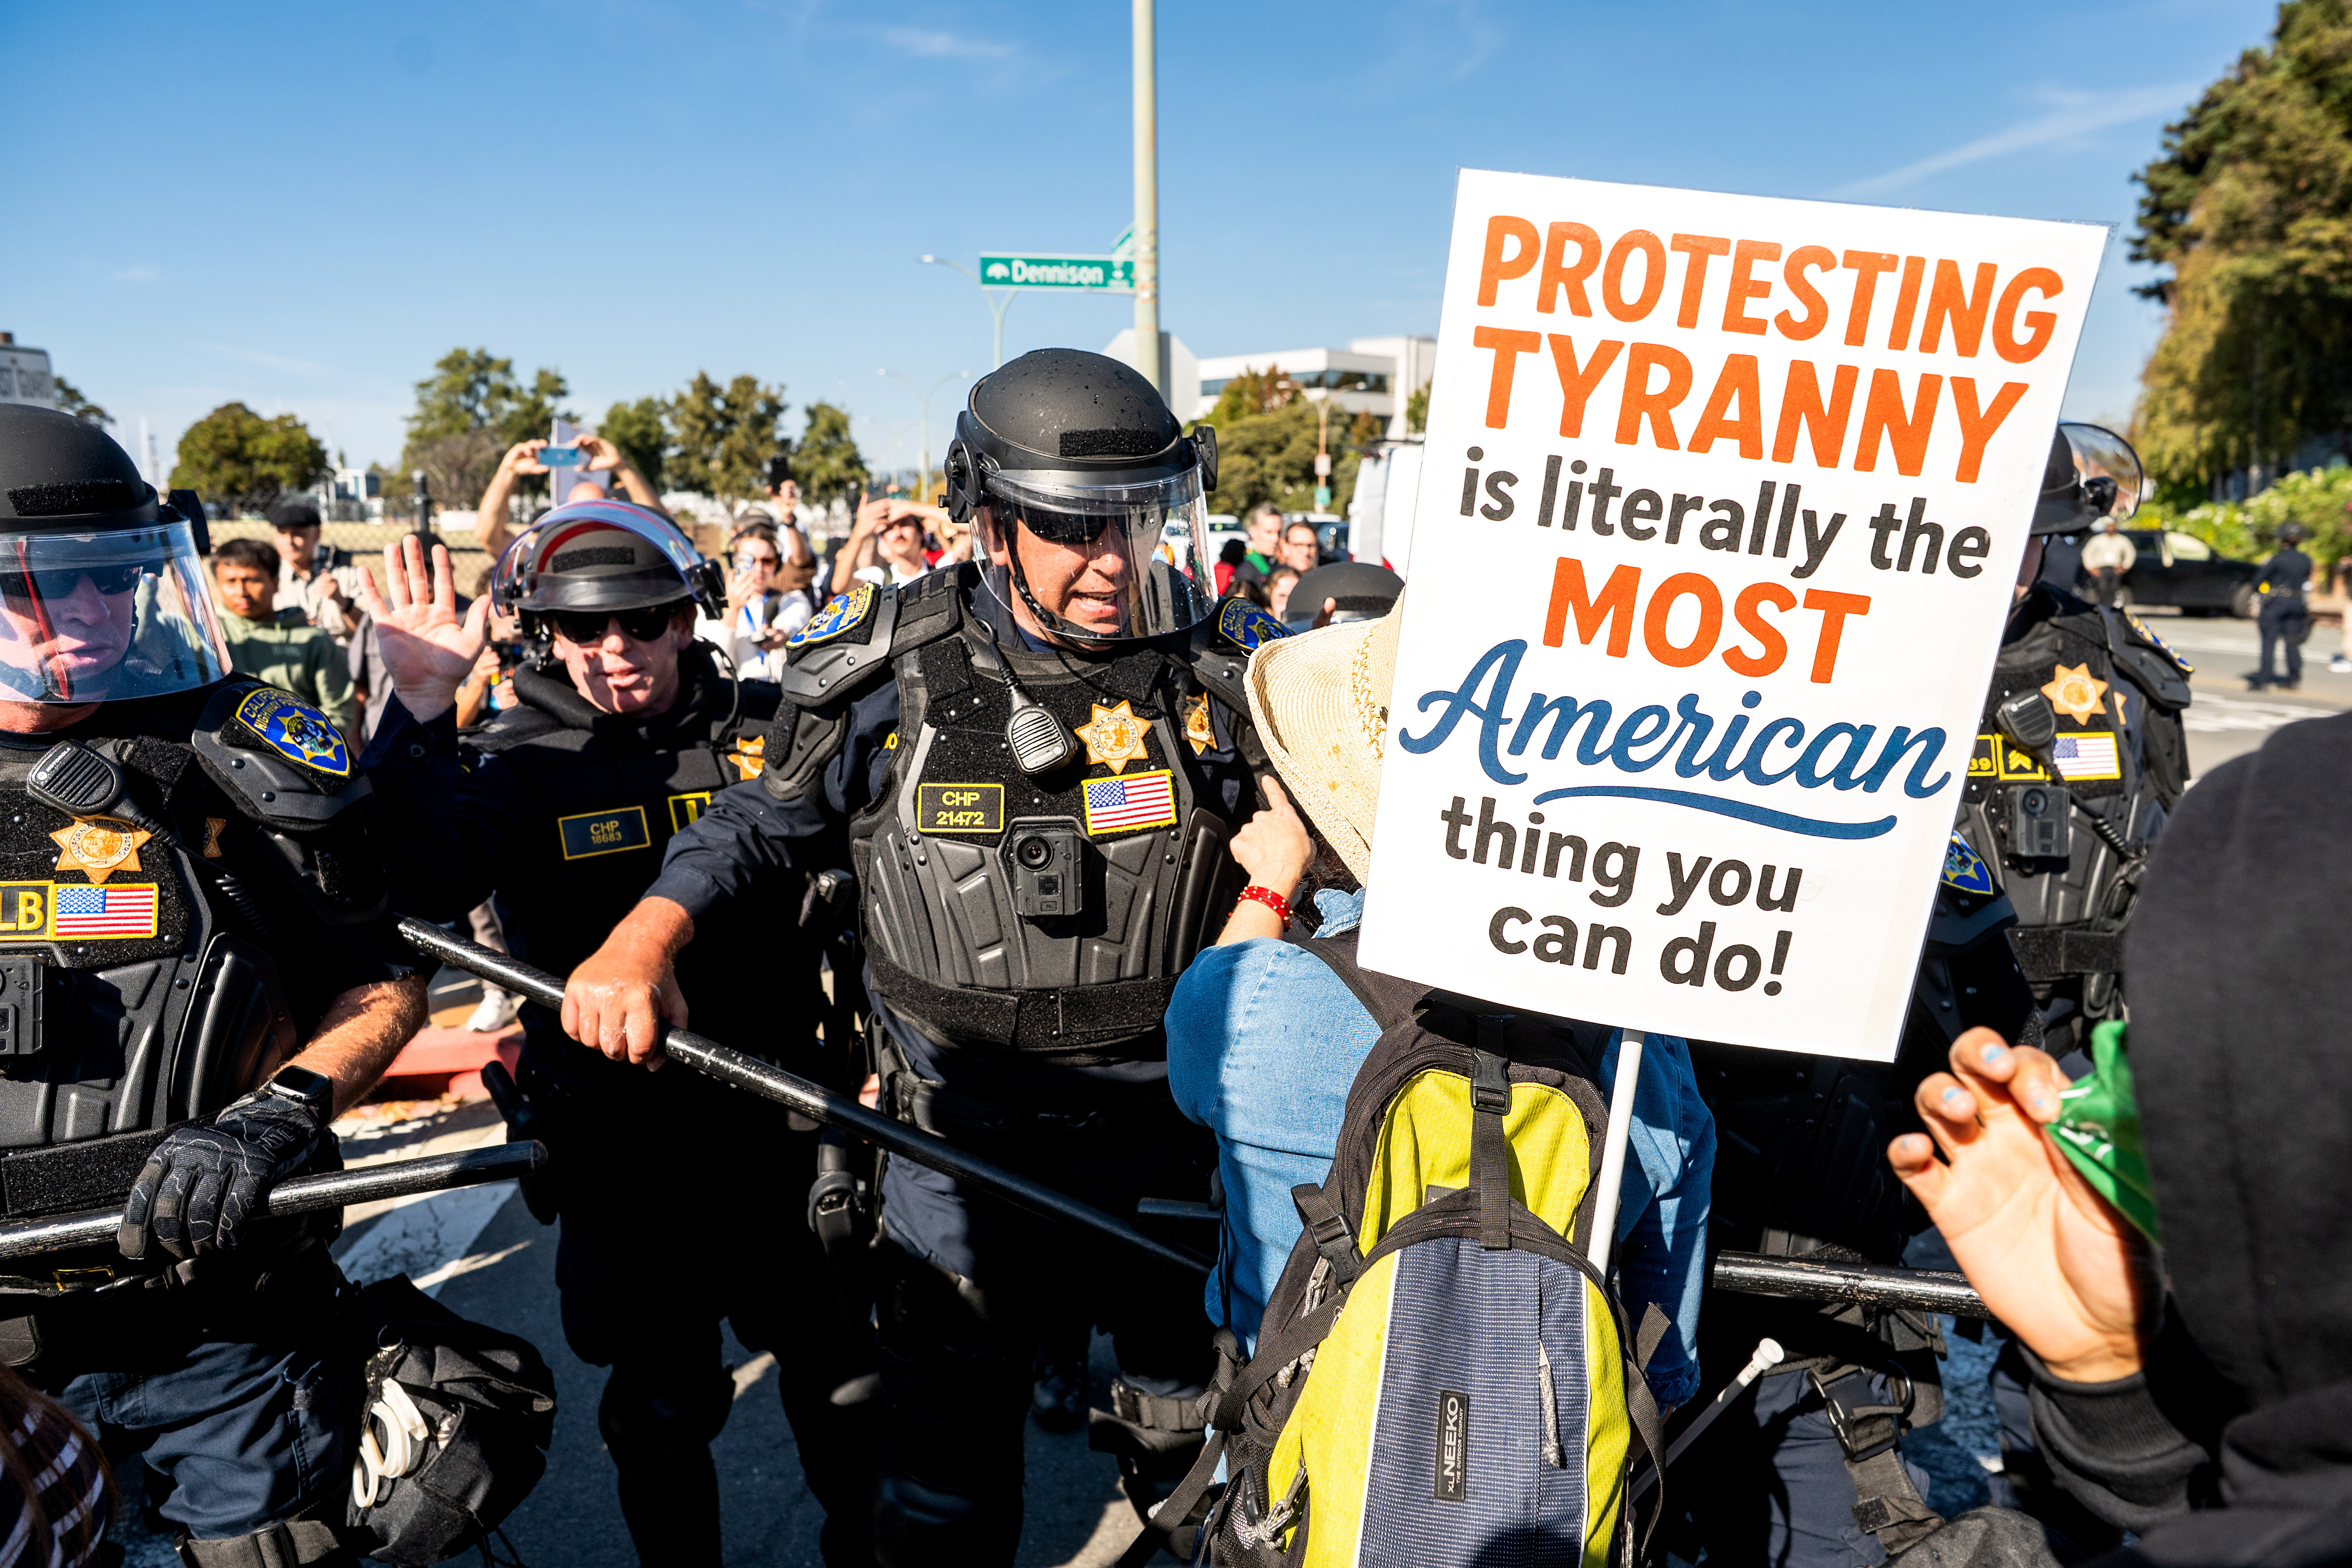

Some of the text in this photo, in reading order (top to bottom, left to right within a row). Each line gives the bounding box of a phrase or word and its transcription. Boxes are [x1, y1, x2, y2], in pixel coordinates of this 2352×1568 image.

[1011, 259, 1104, 284] Dennison
[1477, 215, 2063, 364] PROTESTING
[1473, 326, 2029, 483] TYRANNY
[1460, 447, 1990, 578] is literally the
[1543, 557, 1871, 683] MOST
[254, 700, 282, 732] HIGHWAY
[1092, 715, 1137, 753] CALIFORNIA HIGHWAY PATROL
[1399, 639, 1951, 799] American
[46, 747, 71, 772] MOTOROLA
[942, 791, 980, 806] CHP
[590, 820, 619, 835] CHP
[591, 831, 622, 844] 18683
[936, 811, 985, 826] 21472
[71, 820, 131, 859] CALIFORNIA HIGHWAY PATROL
[1441, 796, 1803, 916] thing you
[1489, 907, 1792, 996] can do!
